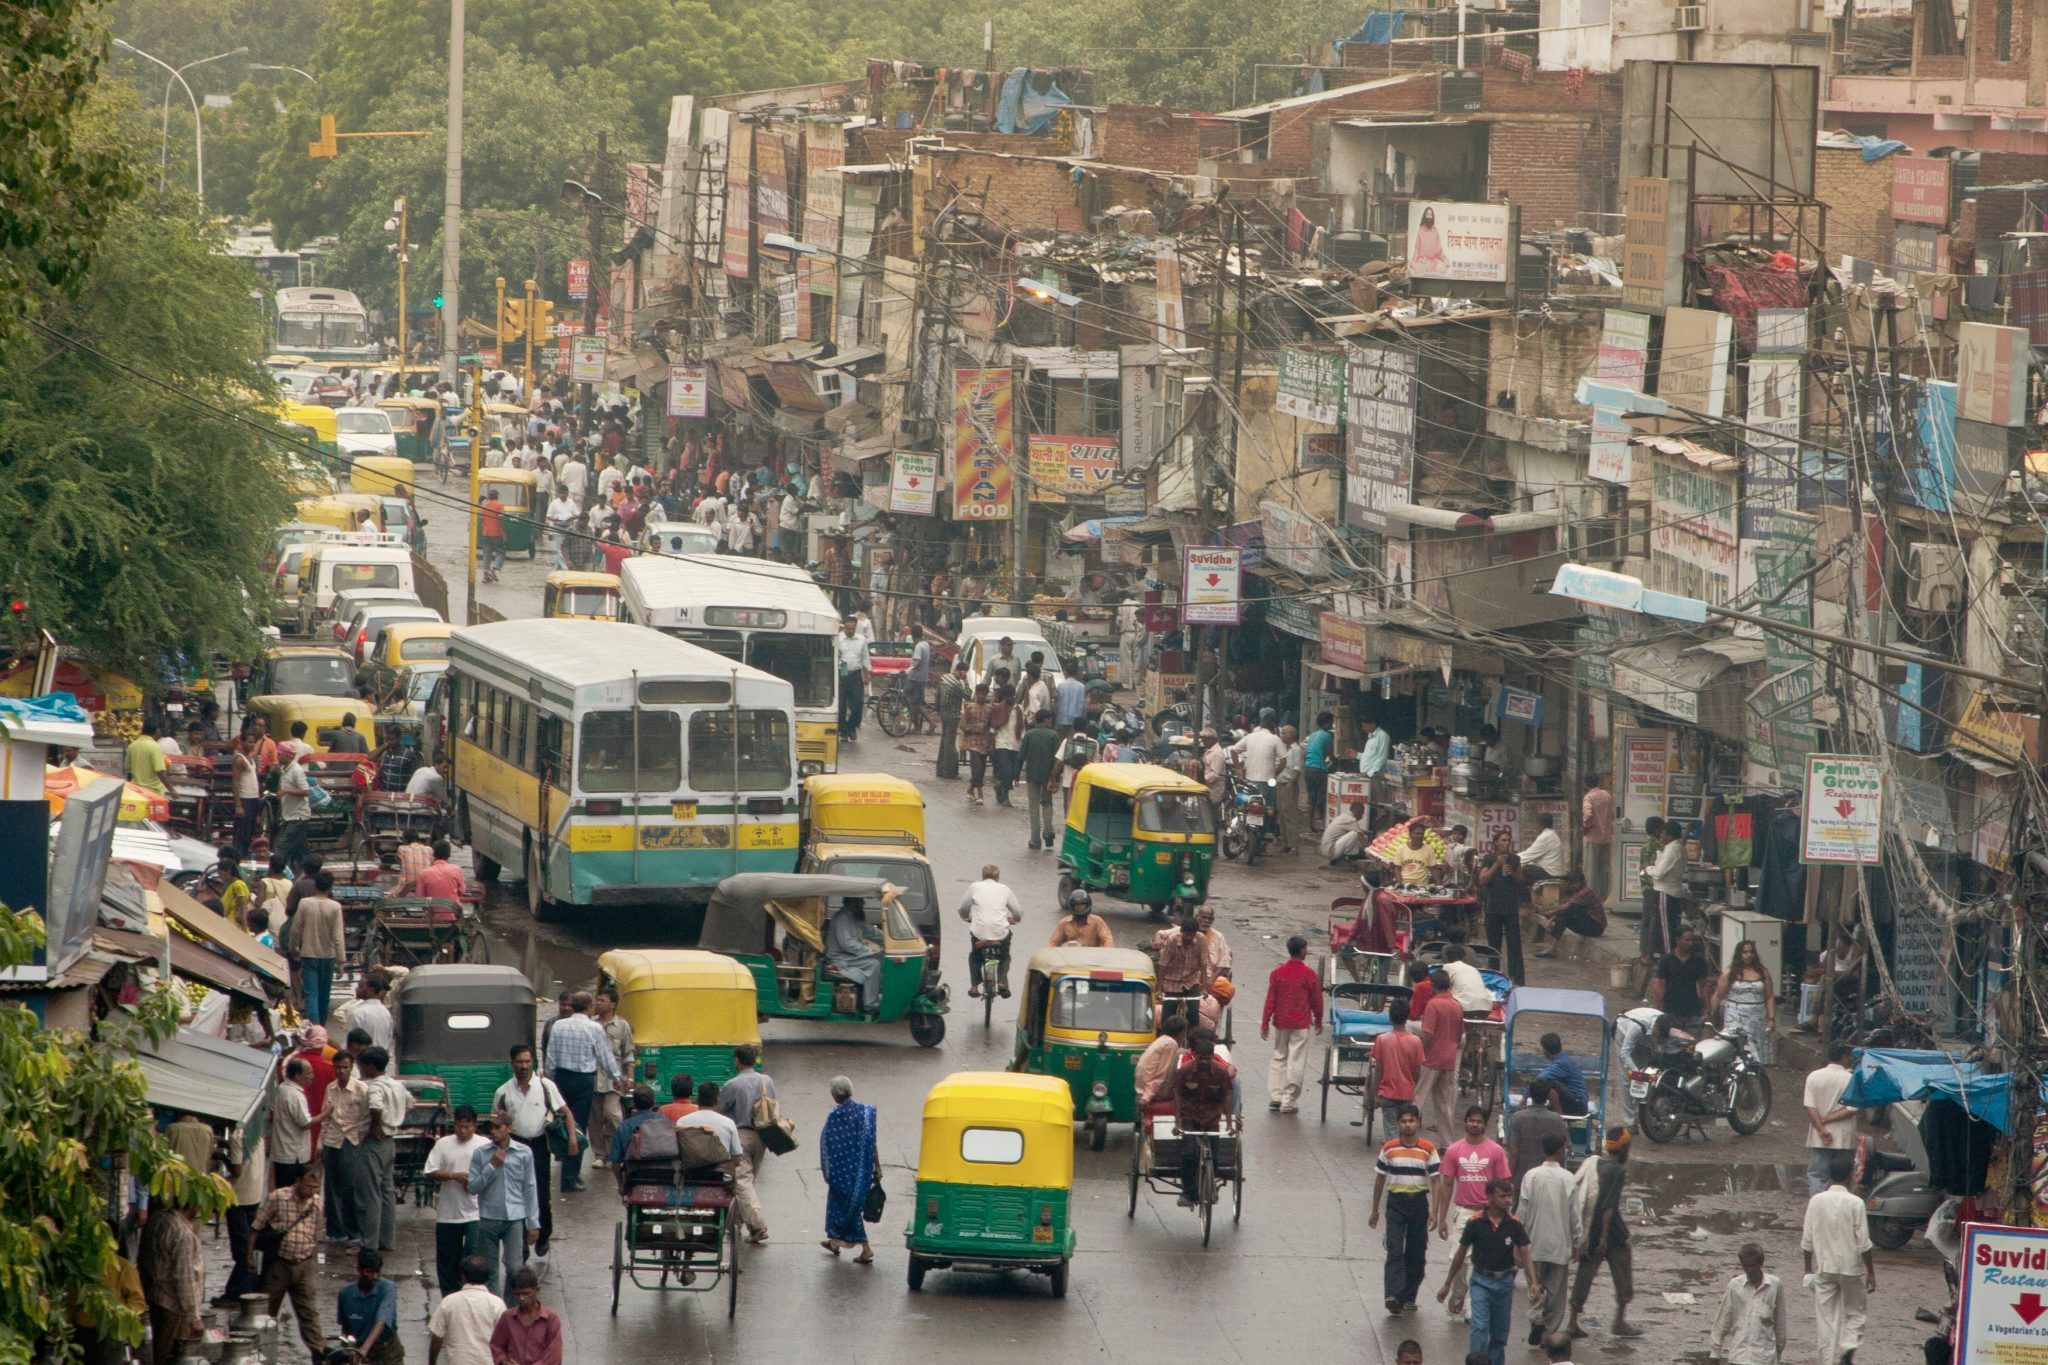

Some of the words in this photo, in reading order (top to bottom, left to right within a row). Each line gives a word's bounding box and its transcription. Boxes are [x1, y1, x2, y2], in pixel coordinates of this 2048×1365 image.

[1916, 169, 1945, 187] TRAVELS
[1633, 185, 1661, 213] HOTEL
[1464, 231, 1478, 250] योग
[1480, 236, 1503, 250] साधना
[897, 455, 924, 465] Palm
[1972, 446, 2004, 475] SAHARA
[902, 463, 934, 473] Grove
[959, 504, 1009, 517] FOOD
[1190, 553, 1232, 565] Suvidha
[680, 608, 688, 617] N
[1813, 761, 1860, 775] Palm
[1822, 775, 1879, 790] Grove
[1824, 788, 1879, 799] Restaurant
[1482, 808, 1516, 822] STD
[1478, 841, 1516, 854] LOL
[1897, 970, 1938, 981] BOMBA
[1899, 985, 1947, 996] NAINITL
[1460, 1173, 1488, 1182] adidas
[1976, 1244, 2048, 1270] Suvid
[1987, 1324, 1994, 1332] A
[1995, 1325, 2040, 1336] Vegetarian's
